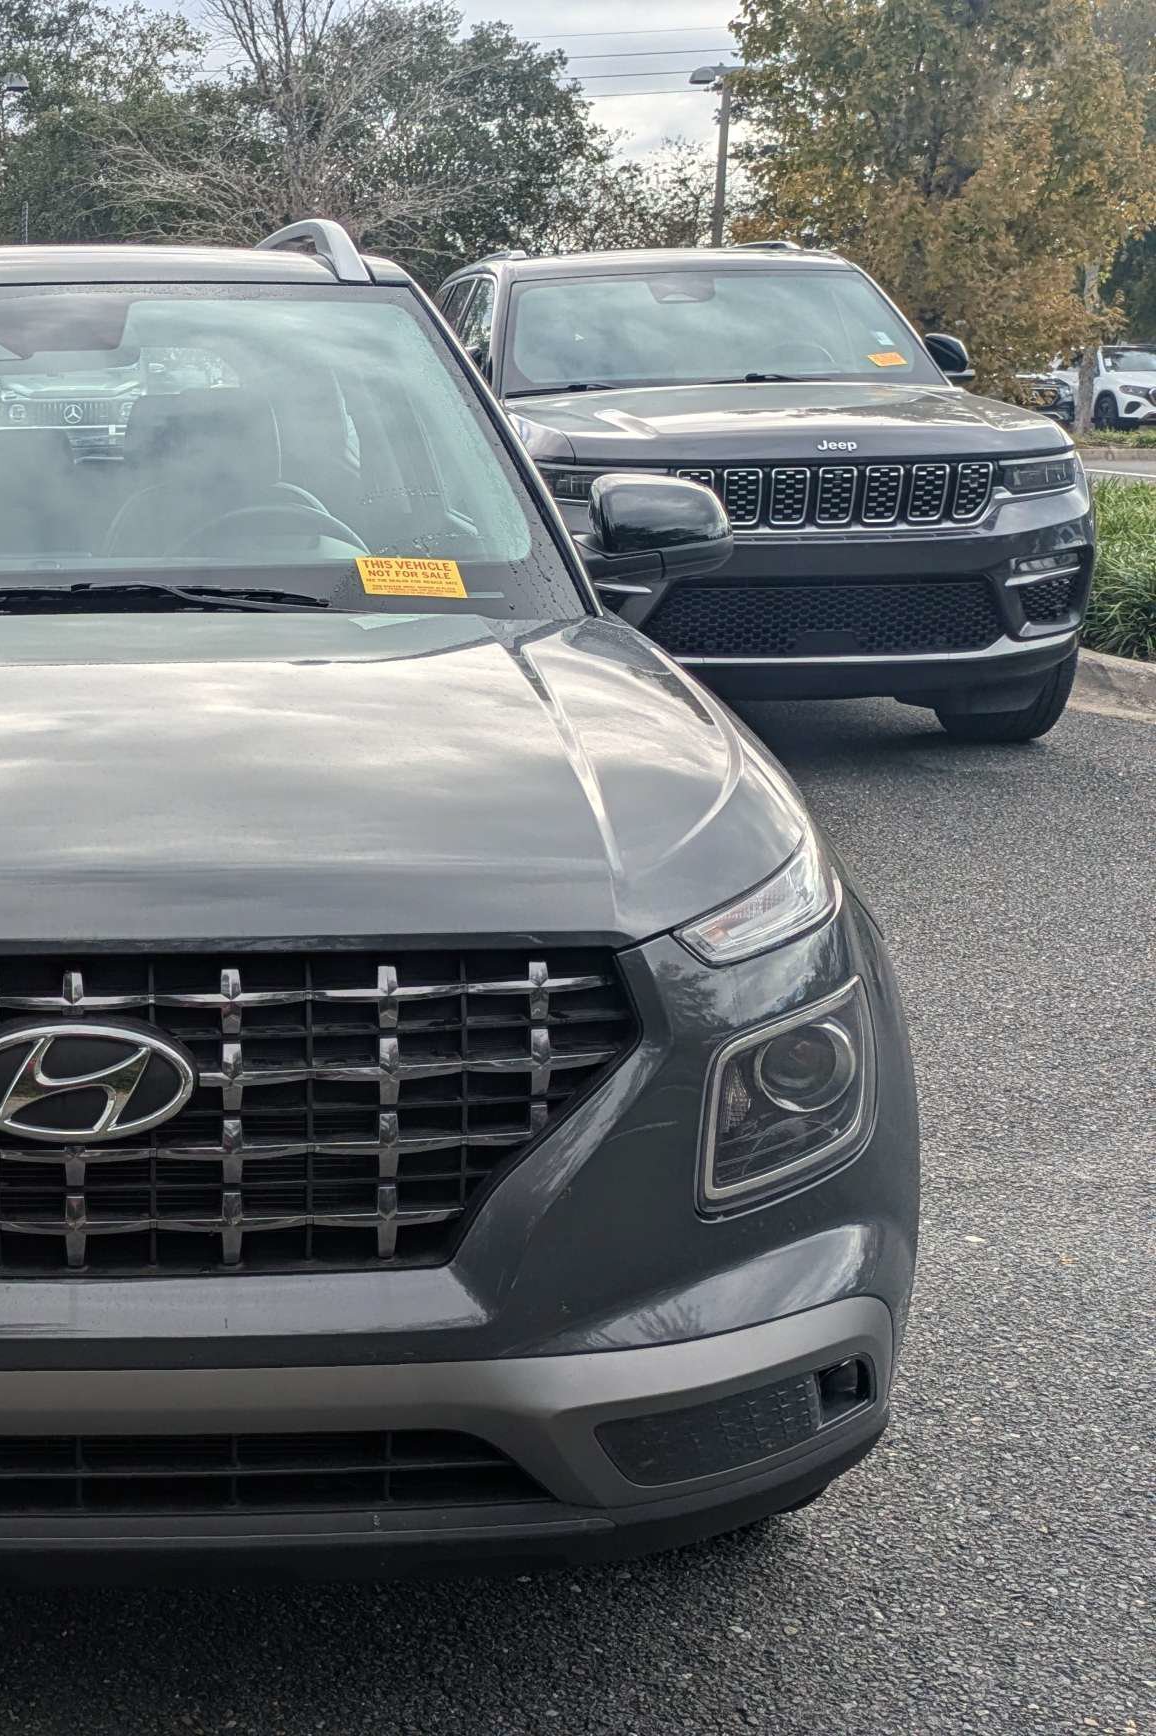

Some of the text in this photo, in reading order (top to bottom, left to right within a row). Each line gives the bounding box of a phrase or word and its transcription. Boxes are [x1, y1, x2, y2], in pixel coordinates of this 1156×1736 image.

[817, 440, 858, 451] Jeep
[363, 560, 451, 572] THIS VEHICLE
[421, 572, 451, 580] SALE
